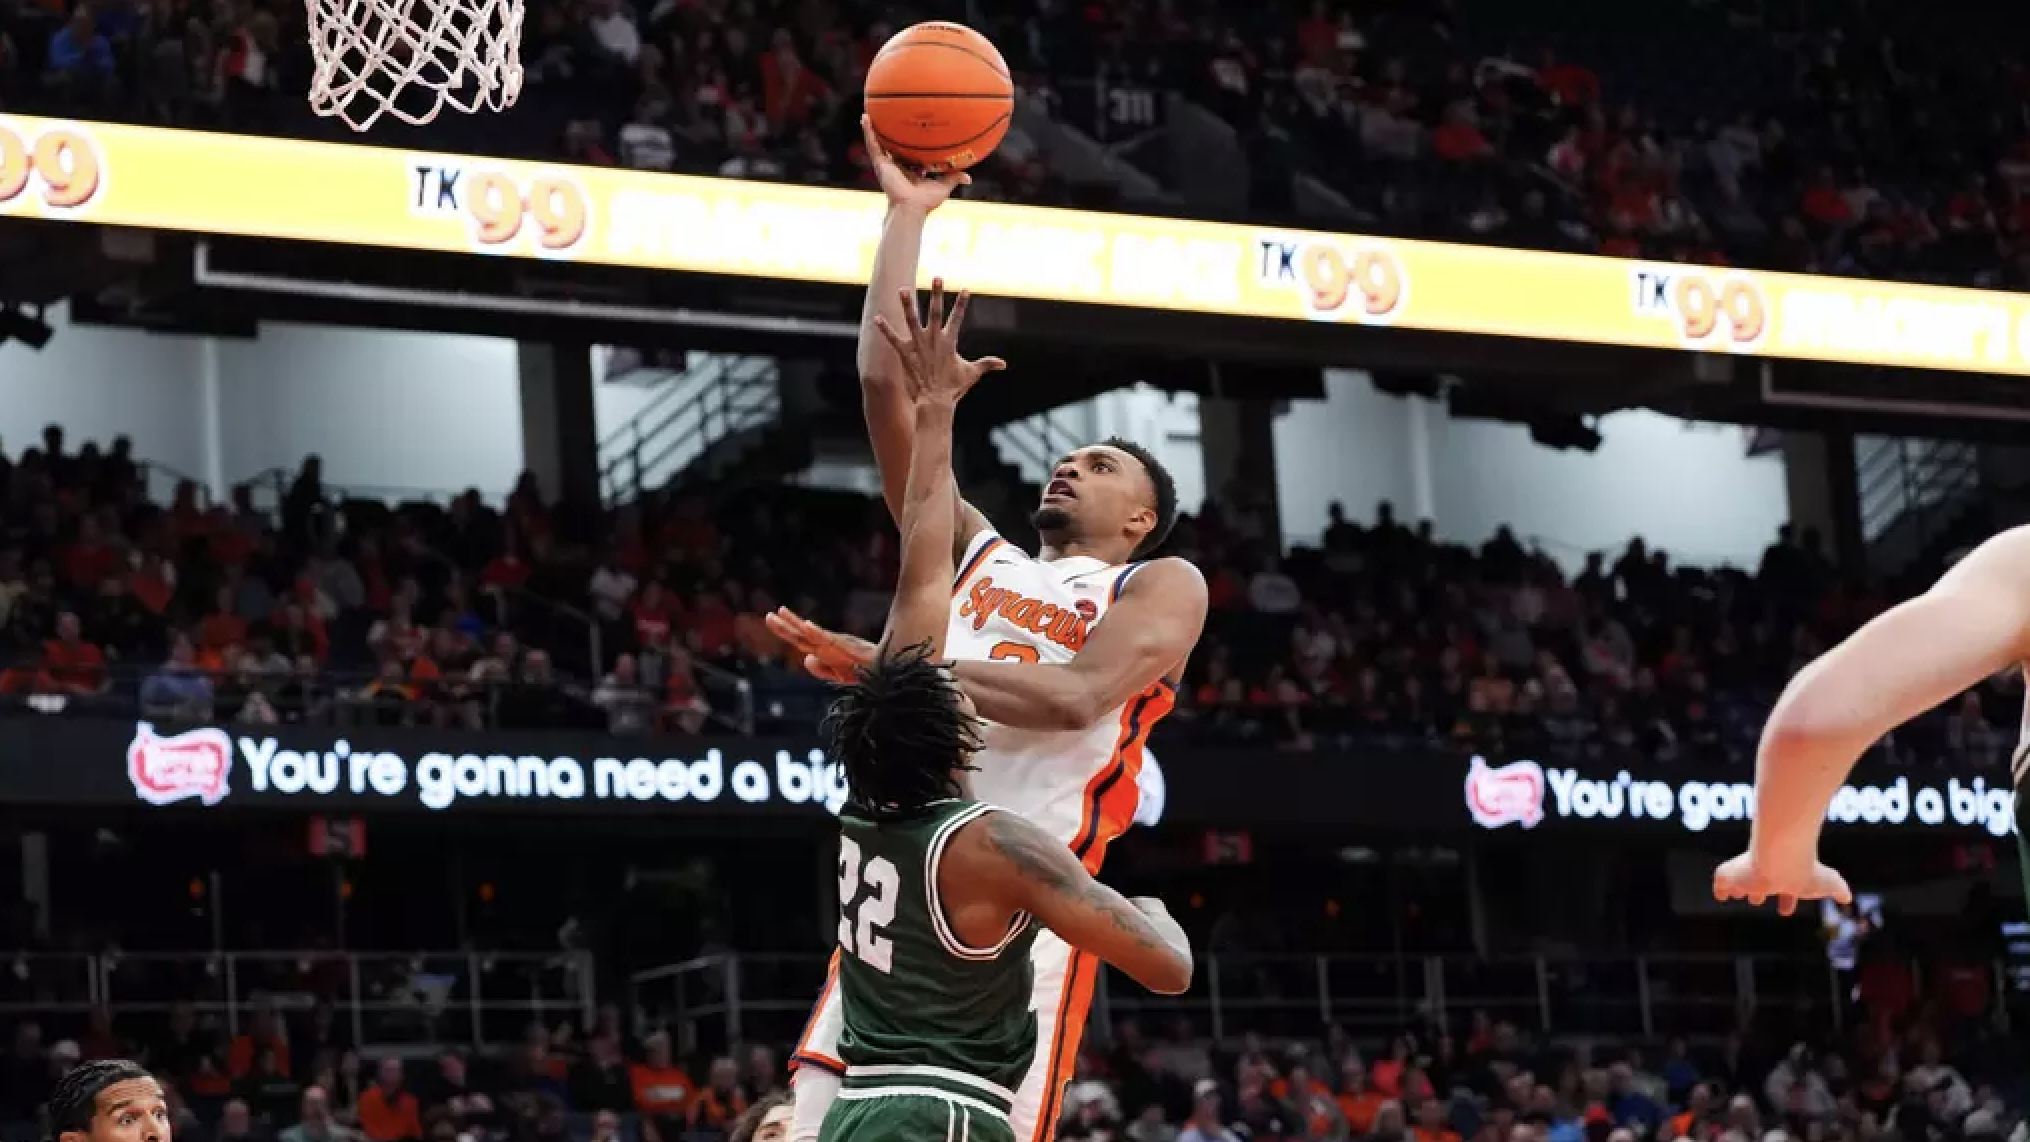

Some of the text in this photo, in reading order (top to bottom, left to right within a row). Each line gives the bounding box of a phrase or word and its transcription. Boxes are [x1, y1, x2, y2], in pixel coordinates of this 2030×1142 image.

[959, 576, 1087, 652] Syracus
[238, 738, 406, 794] You're
[416, 752, 584, 808] gonna
[594, 748, 722, 800] need
[731, 761, 770, 802] a
[1546, 768, 1674, 819] You're
[1678, 780, 1755, 832] gon
[1915, 787, 1944, 825] a
[1948, 776, 2019, 836] big
[838, 834, 900, 974] 22
